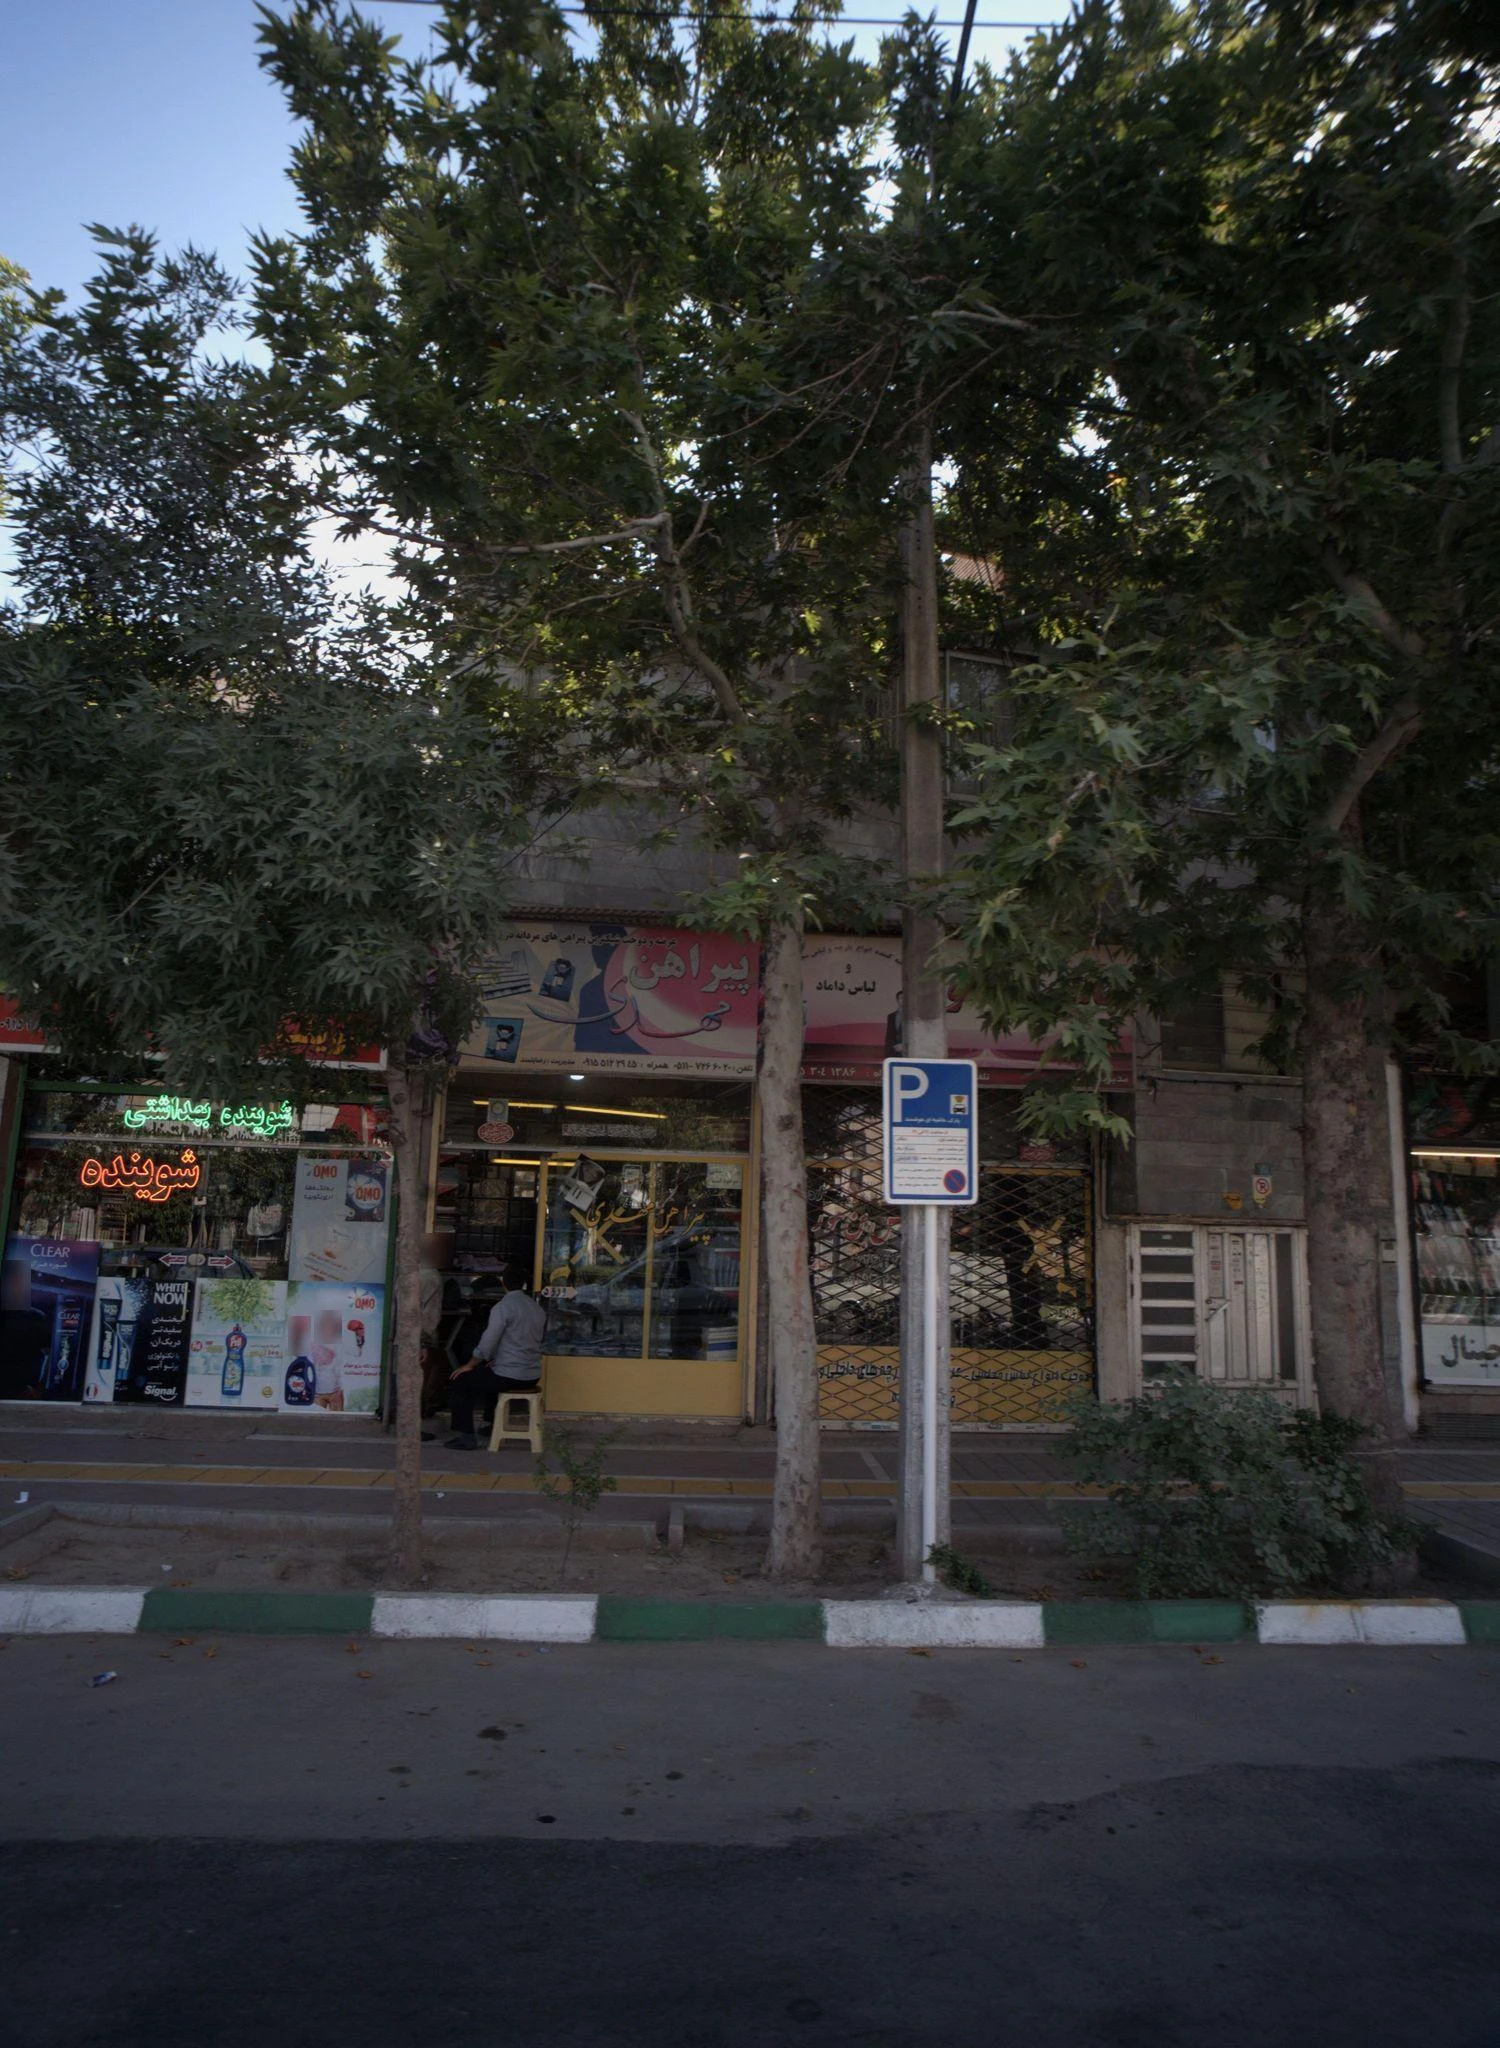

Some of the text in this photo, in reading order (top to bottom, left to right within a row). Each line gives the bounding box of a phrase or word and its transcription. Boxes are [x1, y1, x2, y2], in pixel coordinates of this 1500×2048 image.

[629, 942, 750, 996] پیراهن
[845, 963, 852, 974] و
[816, 979, 876, 995] لباس داماد
[527, 975, 732, 1039] مهدی
[646, 1061, 668, 1070] همراه
[892, 1065, 929, 1122] P
[124, 1095, 293, 1135] شوینده بهداشتی
[80, 1148, 200, 1202] شوینده
[313, 1165, 338, 1178] OMO
[355, 1187, 381, 1201] OMO
[30, 1243, 71, 1258] CLEAR
[153, 1292, 185, 1305] NOW
[354, 1297, 376, 1310] OMO
[144, 1384, 176, 1397] Signal
